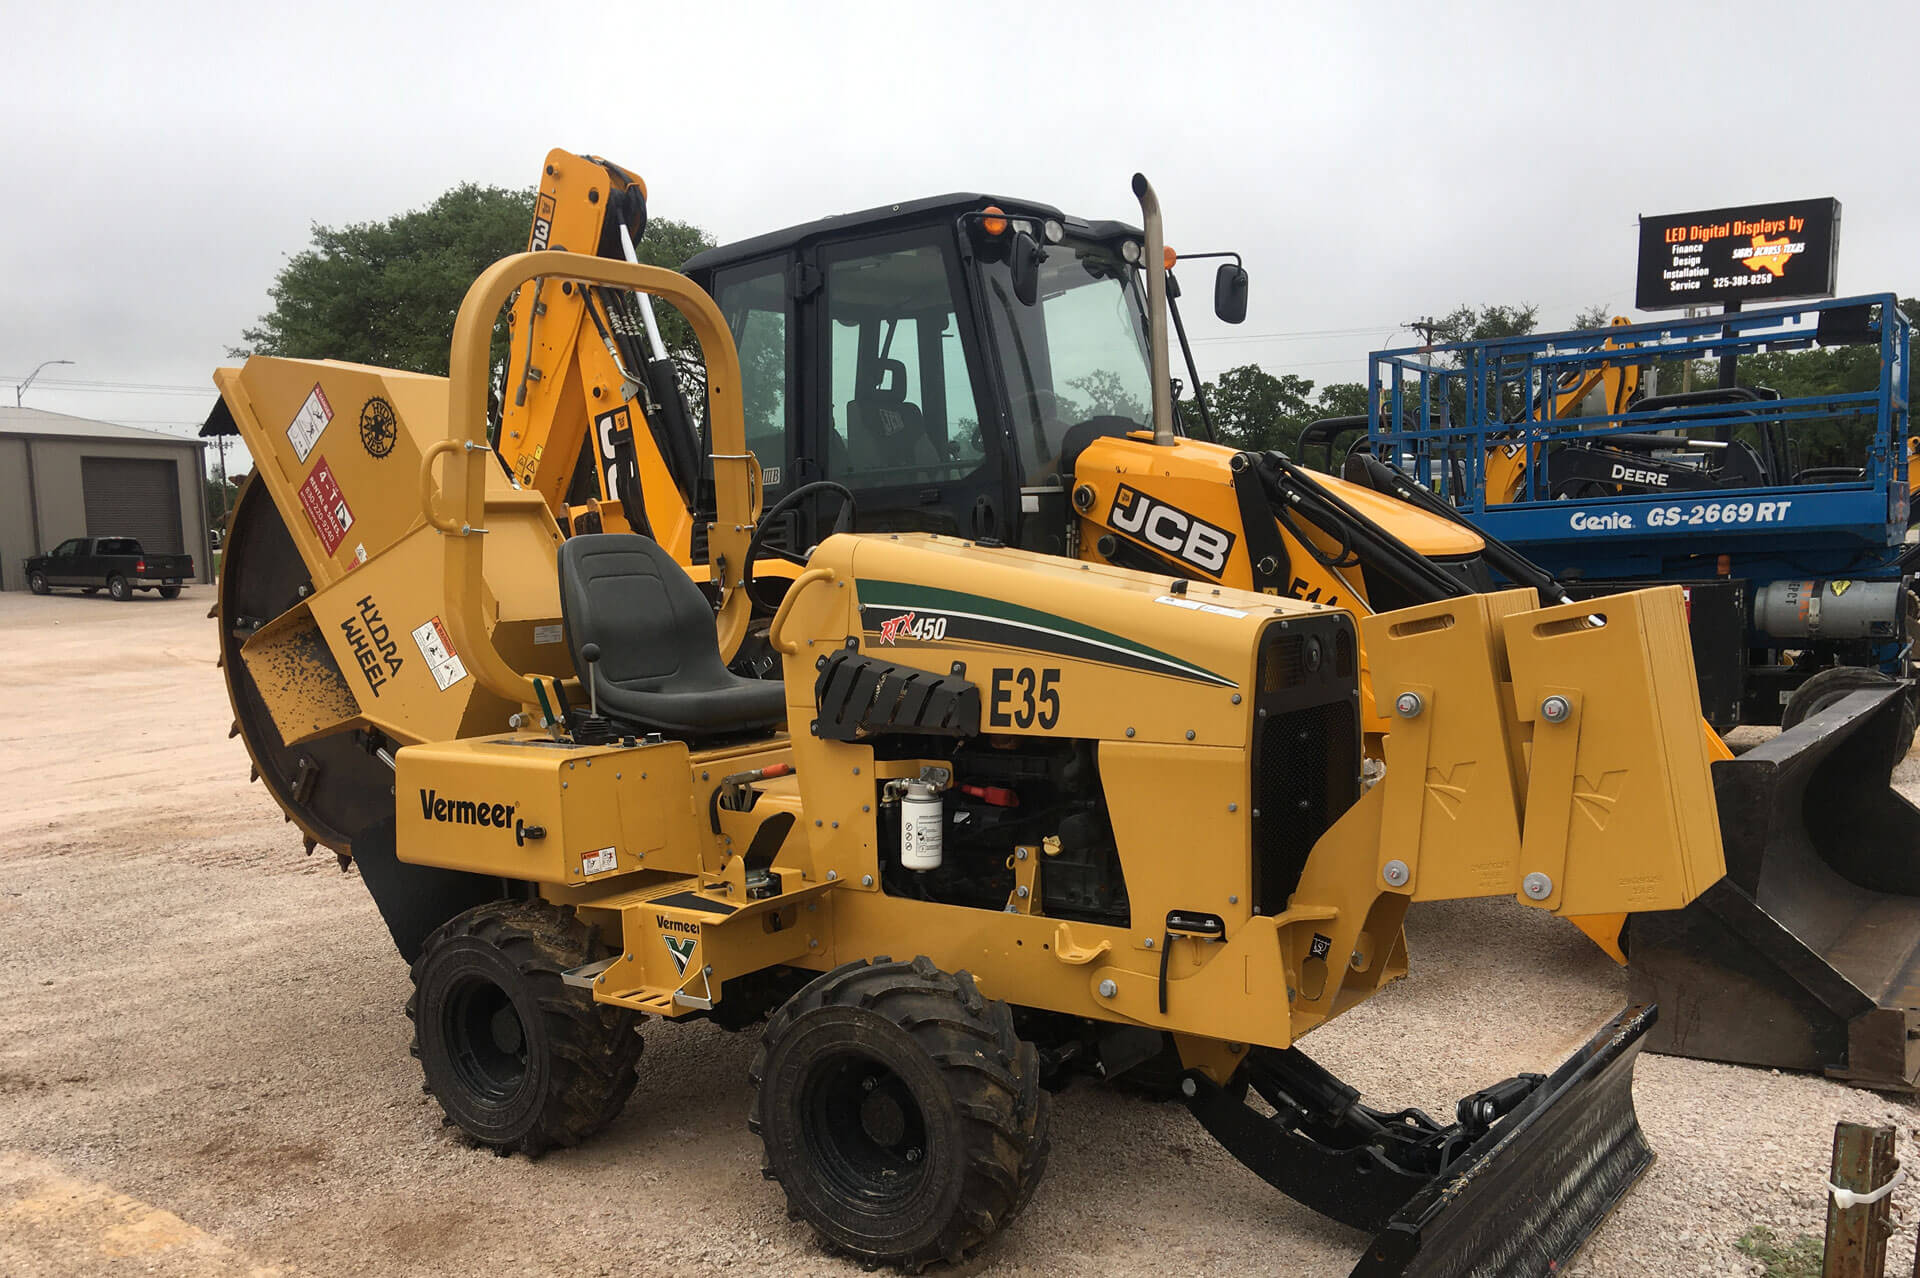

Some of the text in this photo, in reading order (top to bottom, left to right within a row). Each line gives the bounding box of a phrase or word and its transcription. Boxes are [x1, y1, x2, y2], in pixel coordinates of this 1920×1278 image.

[1665, 215, 1804, 243] LED Digital Displays by
[1672, 244, 1704, 255] Finance
[1673, 255, 1701, 267] Design
[1754, 245, 1782, 256] ACROSS
[1783, 242, 1806, 253] TEXAS
[1663, 267, 1709, 280] Installation
[1670, 280, 1700, 291] Service
[1611, 464, 1669, 486] DEERE
[310, 476, 325, 505] RENTAL
[1112, 496, 1229, 571] JCB
[1570, 511, 1632, 531] Genie
[356, 595, 403, 678] HYDRA
[341, 616, 387, 698] WHEEL
[990, 667, 1060, 730] E35
[420, 789, 515, 828] Vermeer
